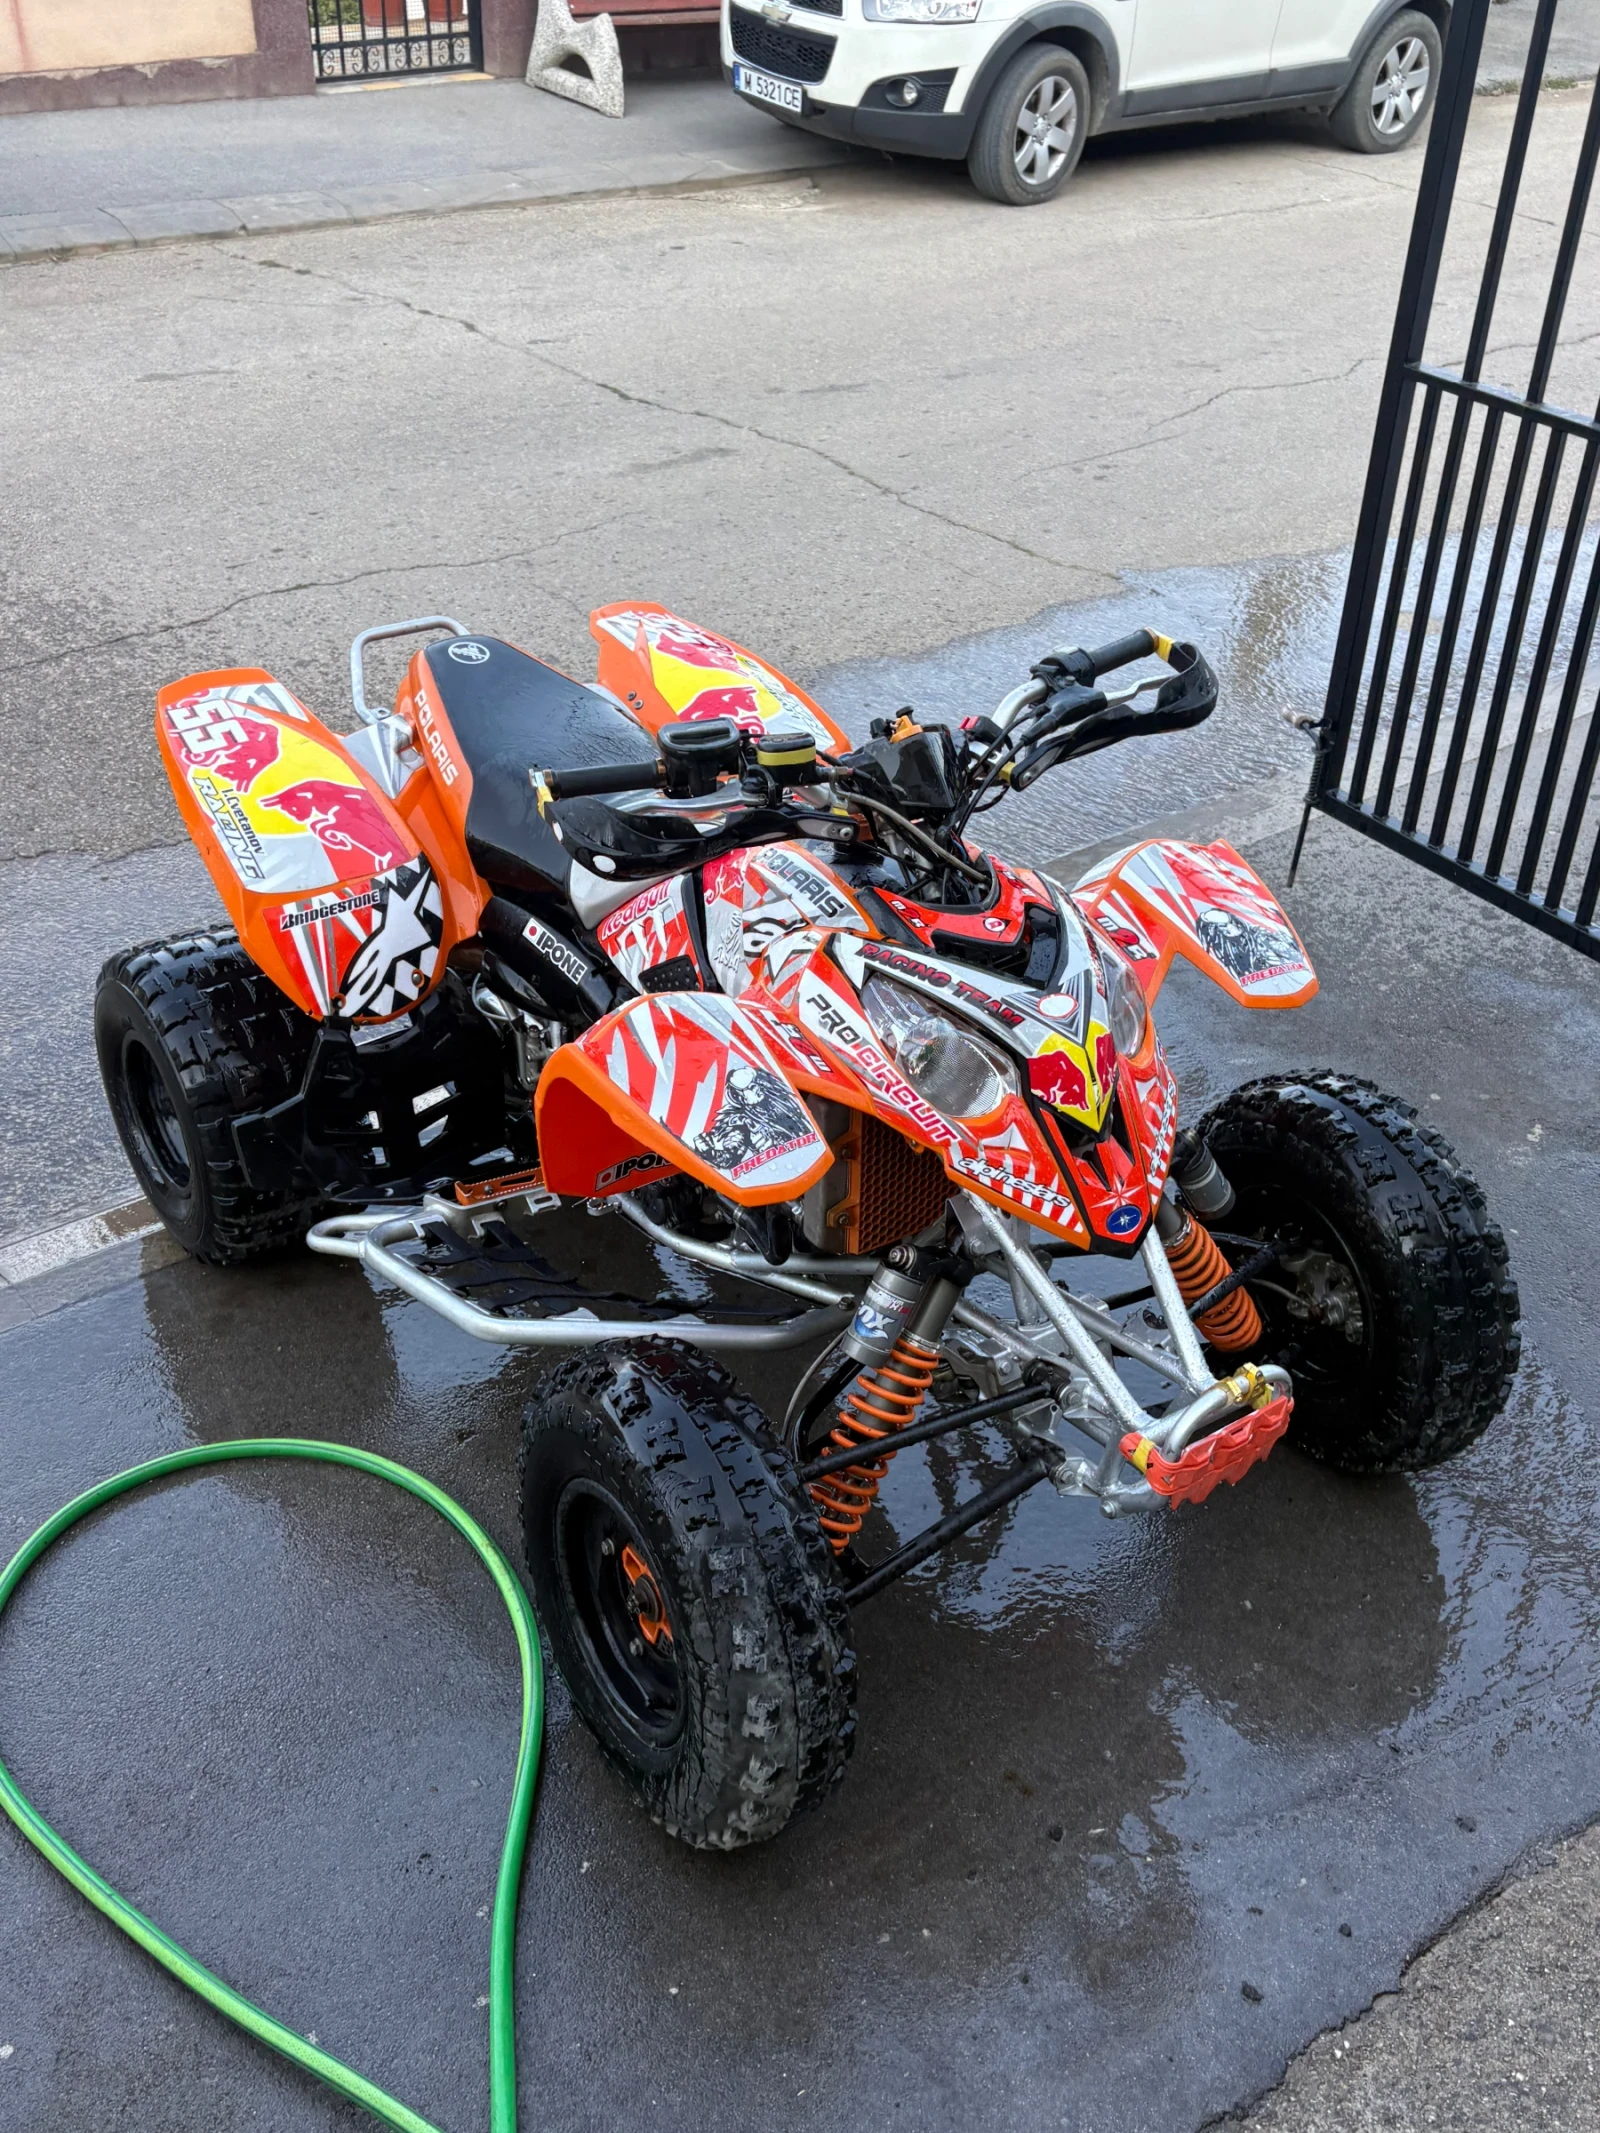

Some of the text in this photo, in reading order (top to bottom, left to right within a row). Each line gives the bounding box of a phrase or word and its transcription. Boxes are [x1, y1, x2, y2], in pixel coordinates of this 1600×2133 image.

[167, 700, 250, 754] 55
[414, 688, 459, 787] POLARIS
[193, 776, 266, 880] RACING
[280, 889, 380, 931] BRIDGESTONE
[601, 878, 675, 941] Red Bull
[762, 847, 848, 919] POLARIS
[534, 929, 589, 985] IPONE
[856, 942, 1026, 1027] RACING TEAM
[806, 993, 961, 1143] PRO CIRCUIT
[731, 1132, 820, 1181] PREDATOR
[957, 1157, 1072, 1208] alpinestars
